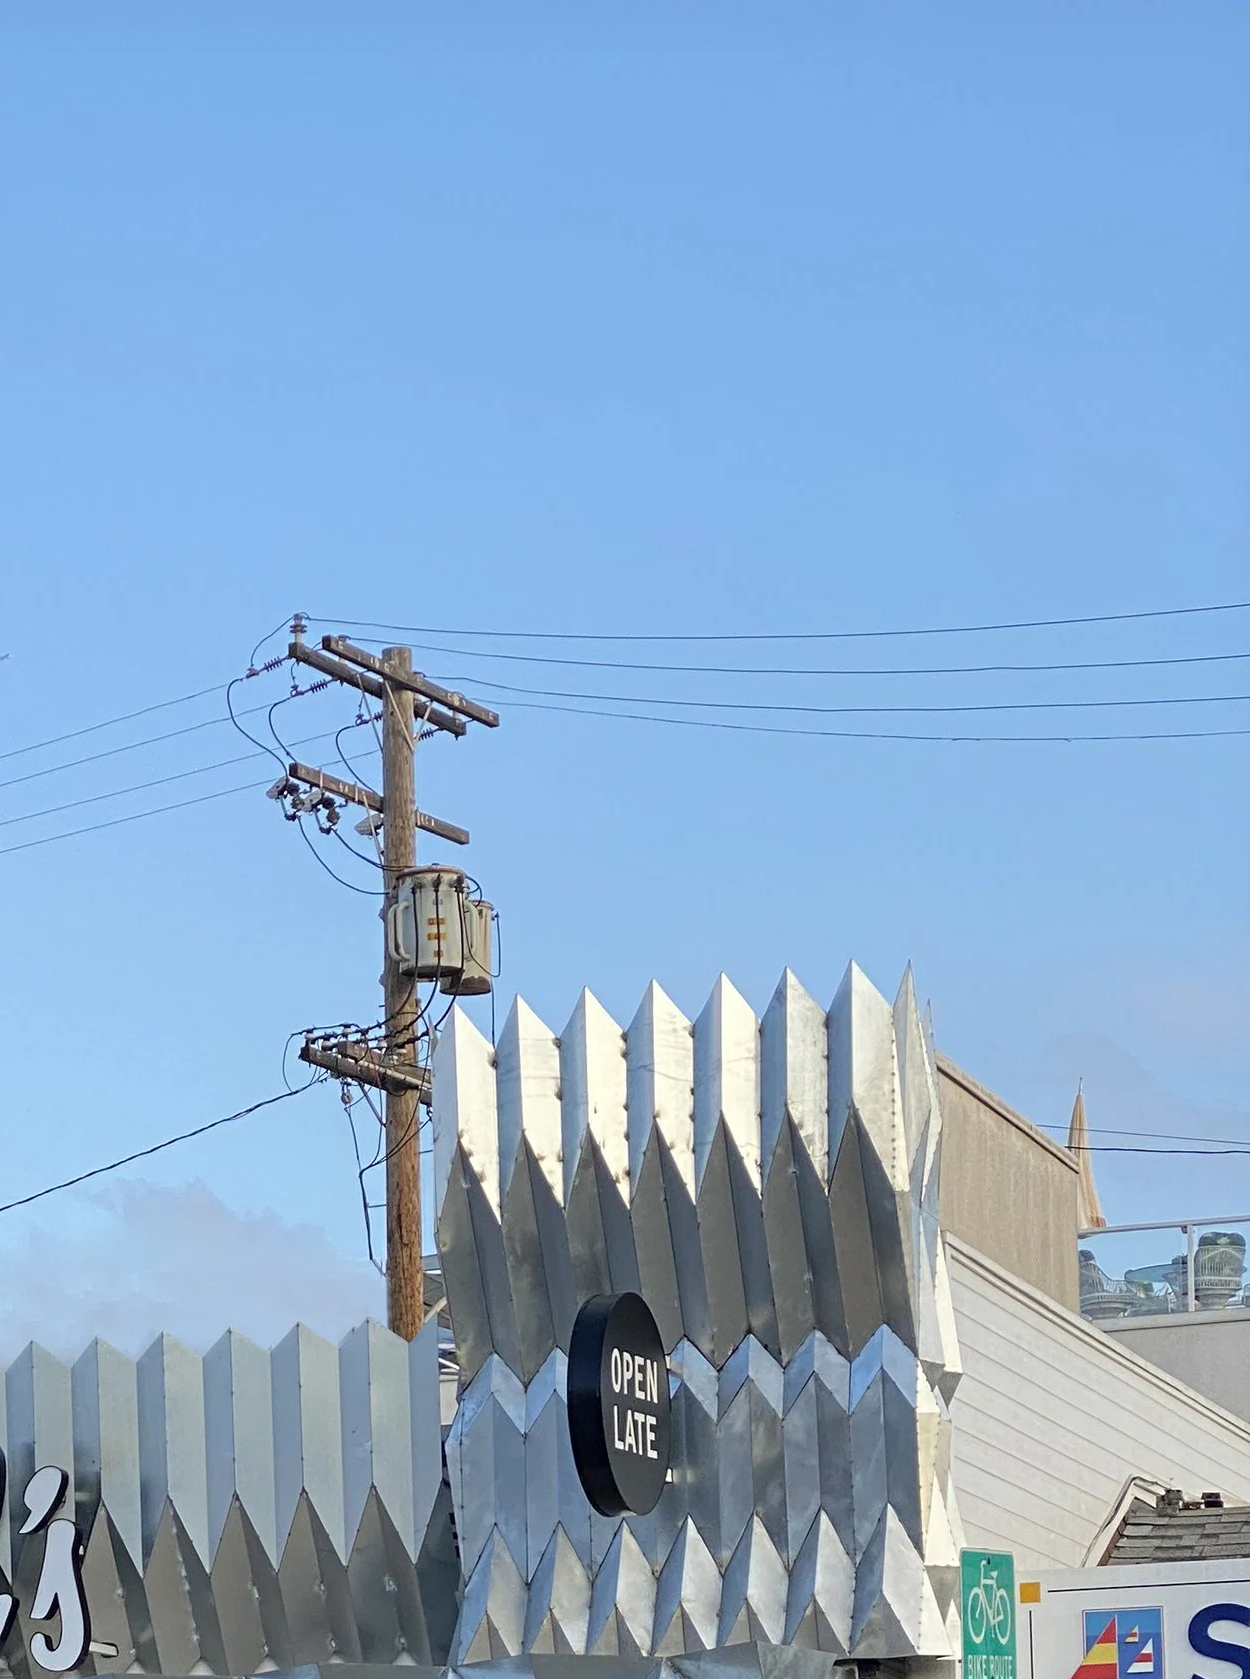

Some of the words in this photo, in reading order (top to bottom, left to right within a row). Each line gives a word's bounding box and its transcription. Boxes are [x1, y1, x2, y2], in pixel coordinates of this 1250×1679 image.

[611, 1348, 658, 1404] OPEN
[613, 1405, 658, 1460] LATE
[968, 1655, 988, 1679] BIKE
